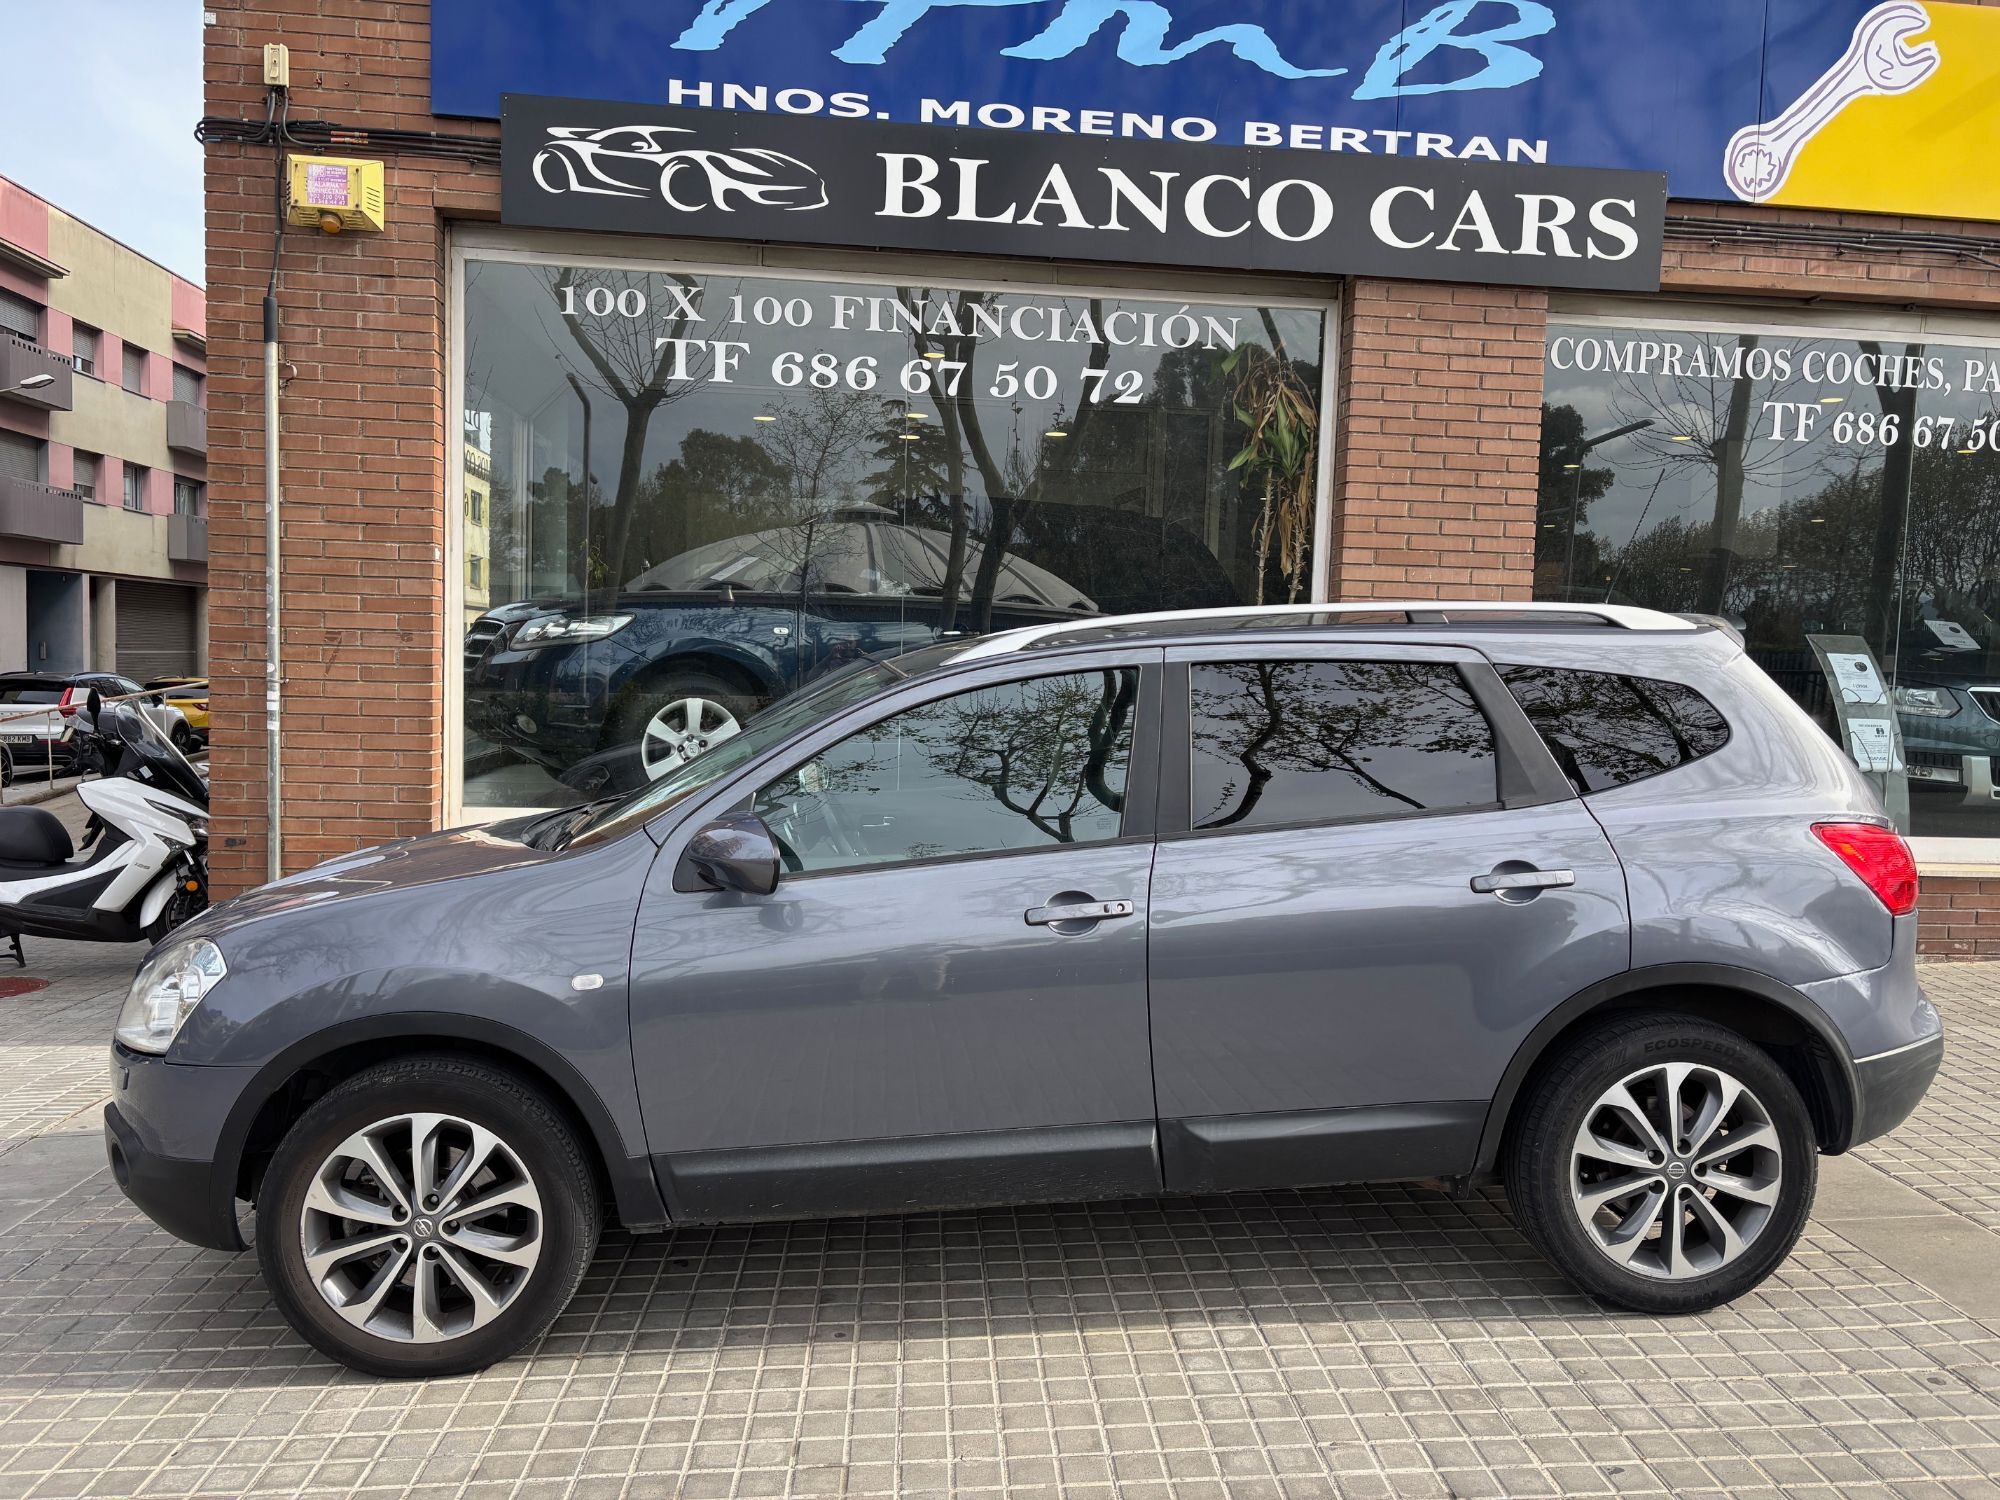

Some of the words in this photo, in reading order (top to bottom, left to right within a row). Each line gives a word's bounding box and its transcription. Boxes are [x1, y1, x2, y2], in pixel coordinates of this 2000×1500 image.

[669, 80, 889, 119] HNOS.
[921, 99, 1216, 141] MORENO
[1244, 122, 1548, 164] BERTRAN
[875, 152, 1333, 242] BLANCO
[1369, 186, 1638, 261] CARS
[560, 286, 647, 318] 100
[663, 286, 706, 322] X
[729, 295, 813, 327] 100
[830, 295, 1242, 352] FINANCIACIÓN
[655, 337, 750, 383] TF
[772, 352, 878, 391] 686
[900, 359, 968, 397] 67
[990, 361, 1058, 400] 50
[1080, 367, 1143, 404] 72
[1550, 336, 1792, 382] COMPRAMOS
[1803, 350, 1953, 397] COCHES,
[1763, 402, 1822, 442] TF
[1833, 411, 1900, 446] 686
[1913, 416, 1956, 450] 67
